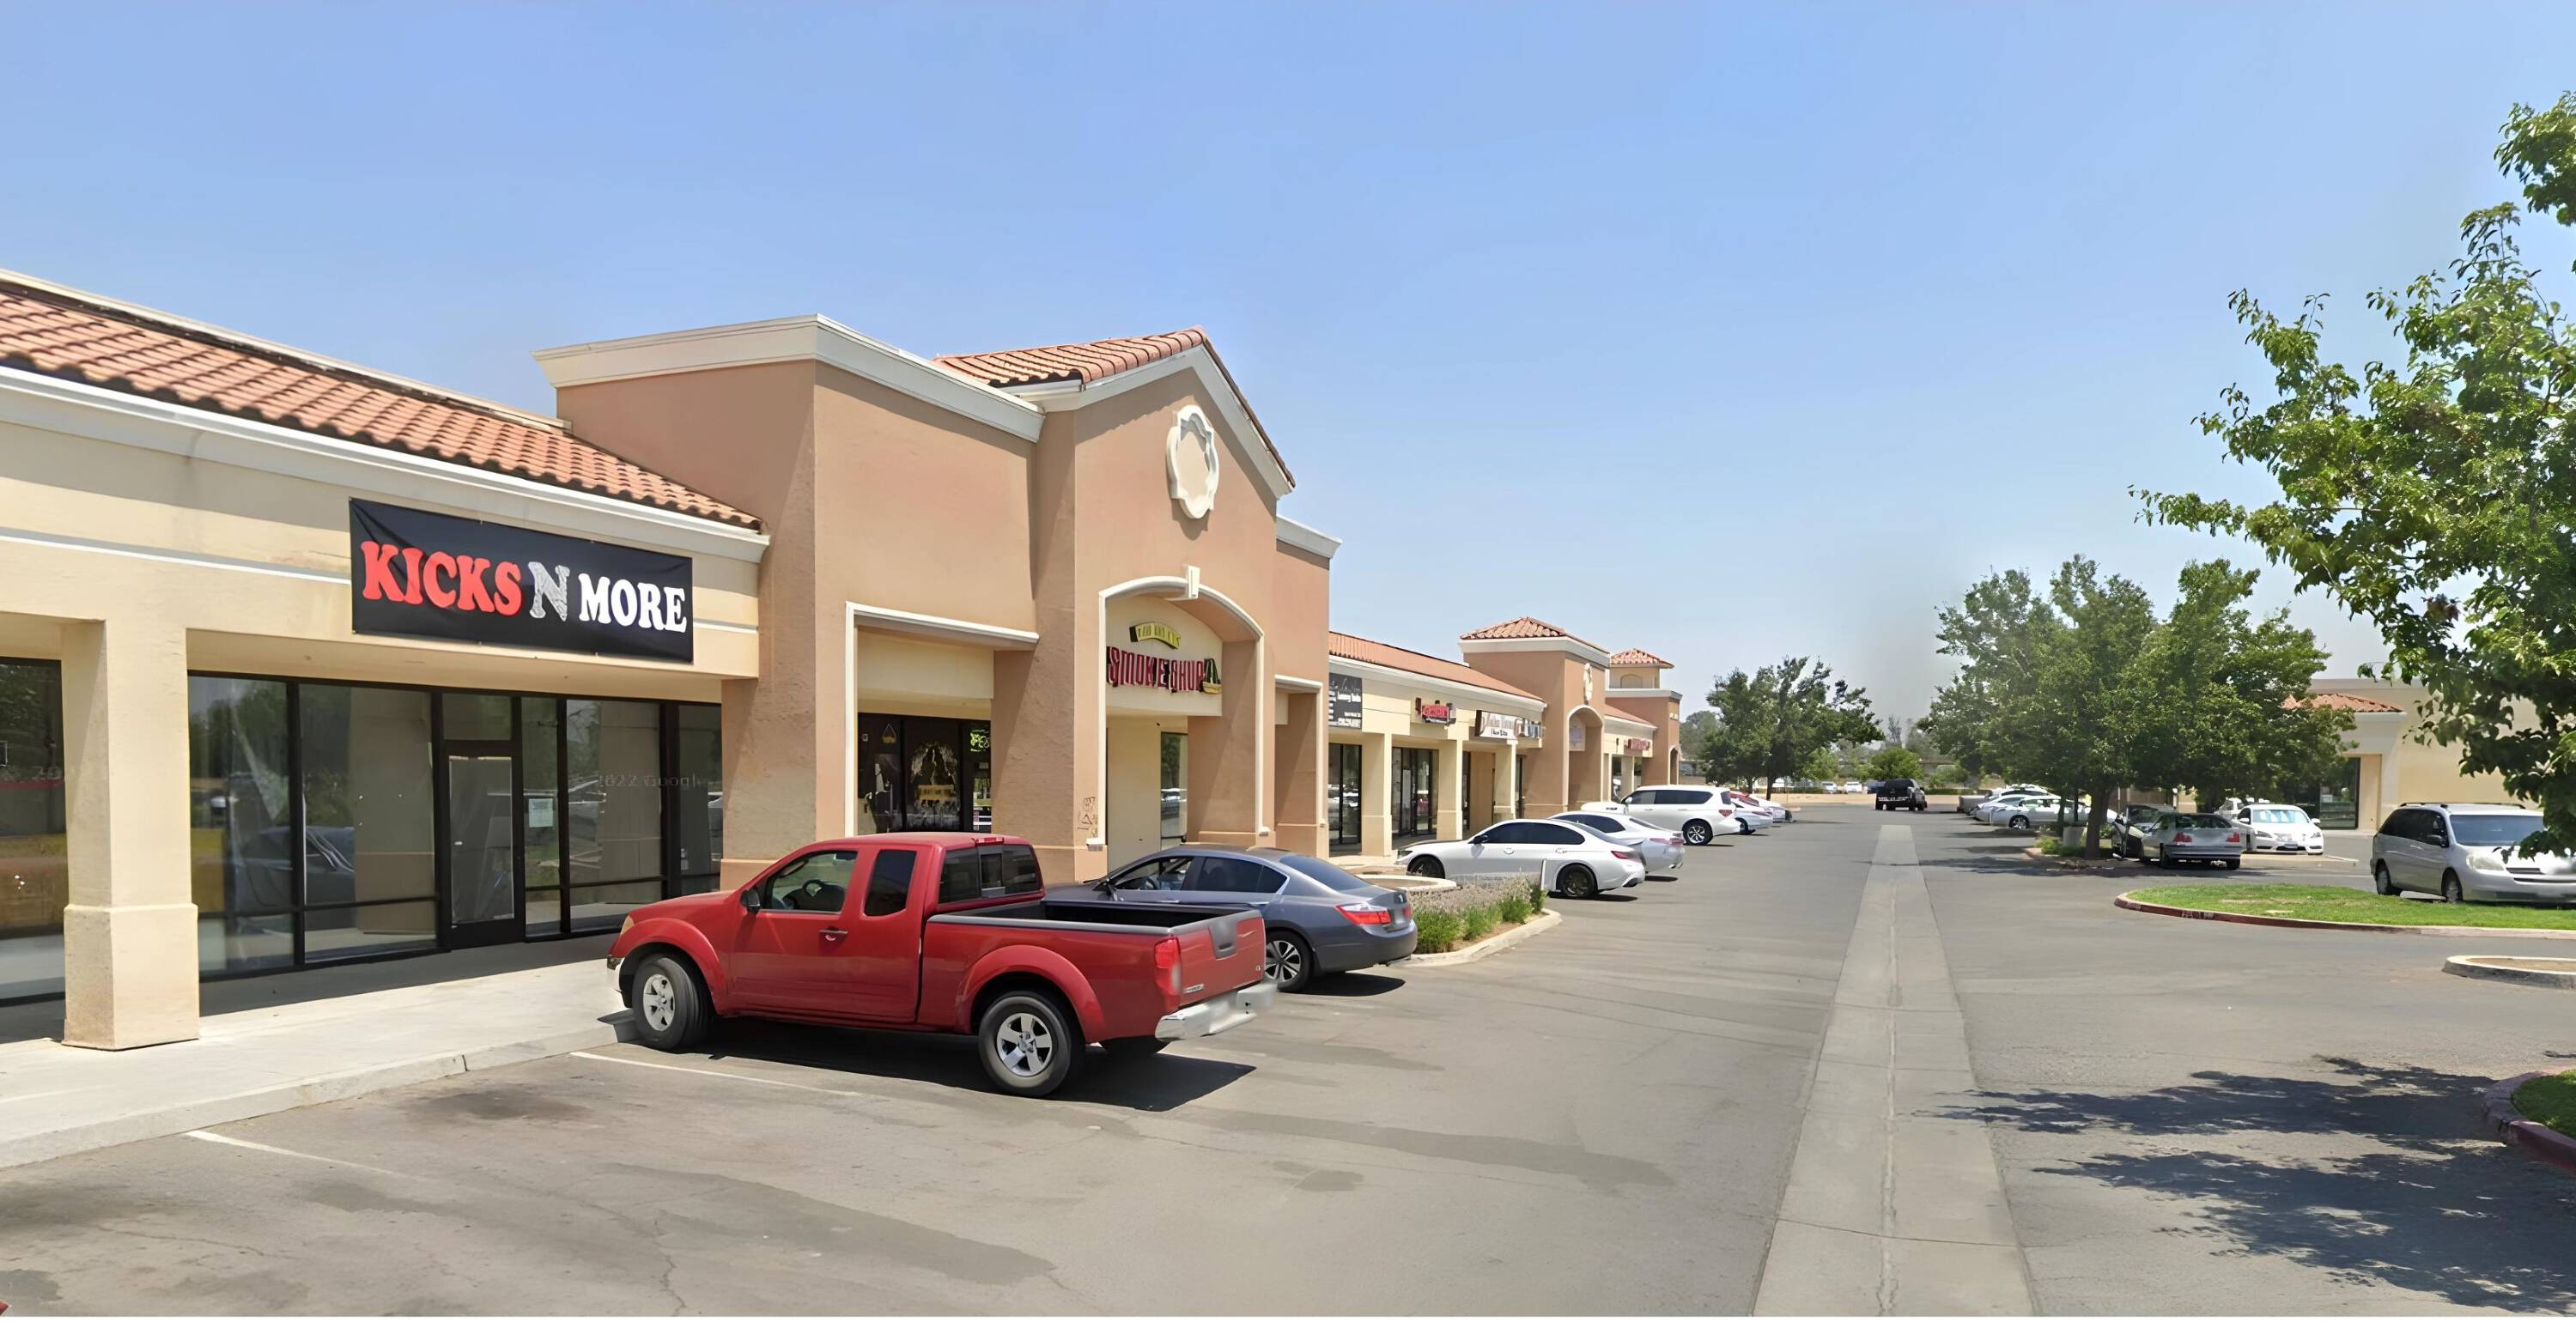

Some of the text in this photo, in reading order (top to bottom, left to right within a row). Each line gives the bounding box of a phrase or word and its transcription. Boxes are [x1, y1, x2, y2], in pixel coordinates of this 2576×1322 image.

[361, 541, 687, 633] KICKS N MORE
[1107, 646, 1170, 688] SMOKE
